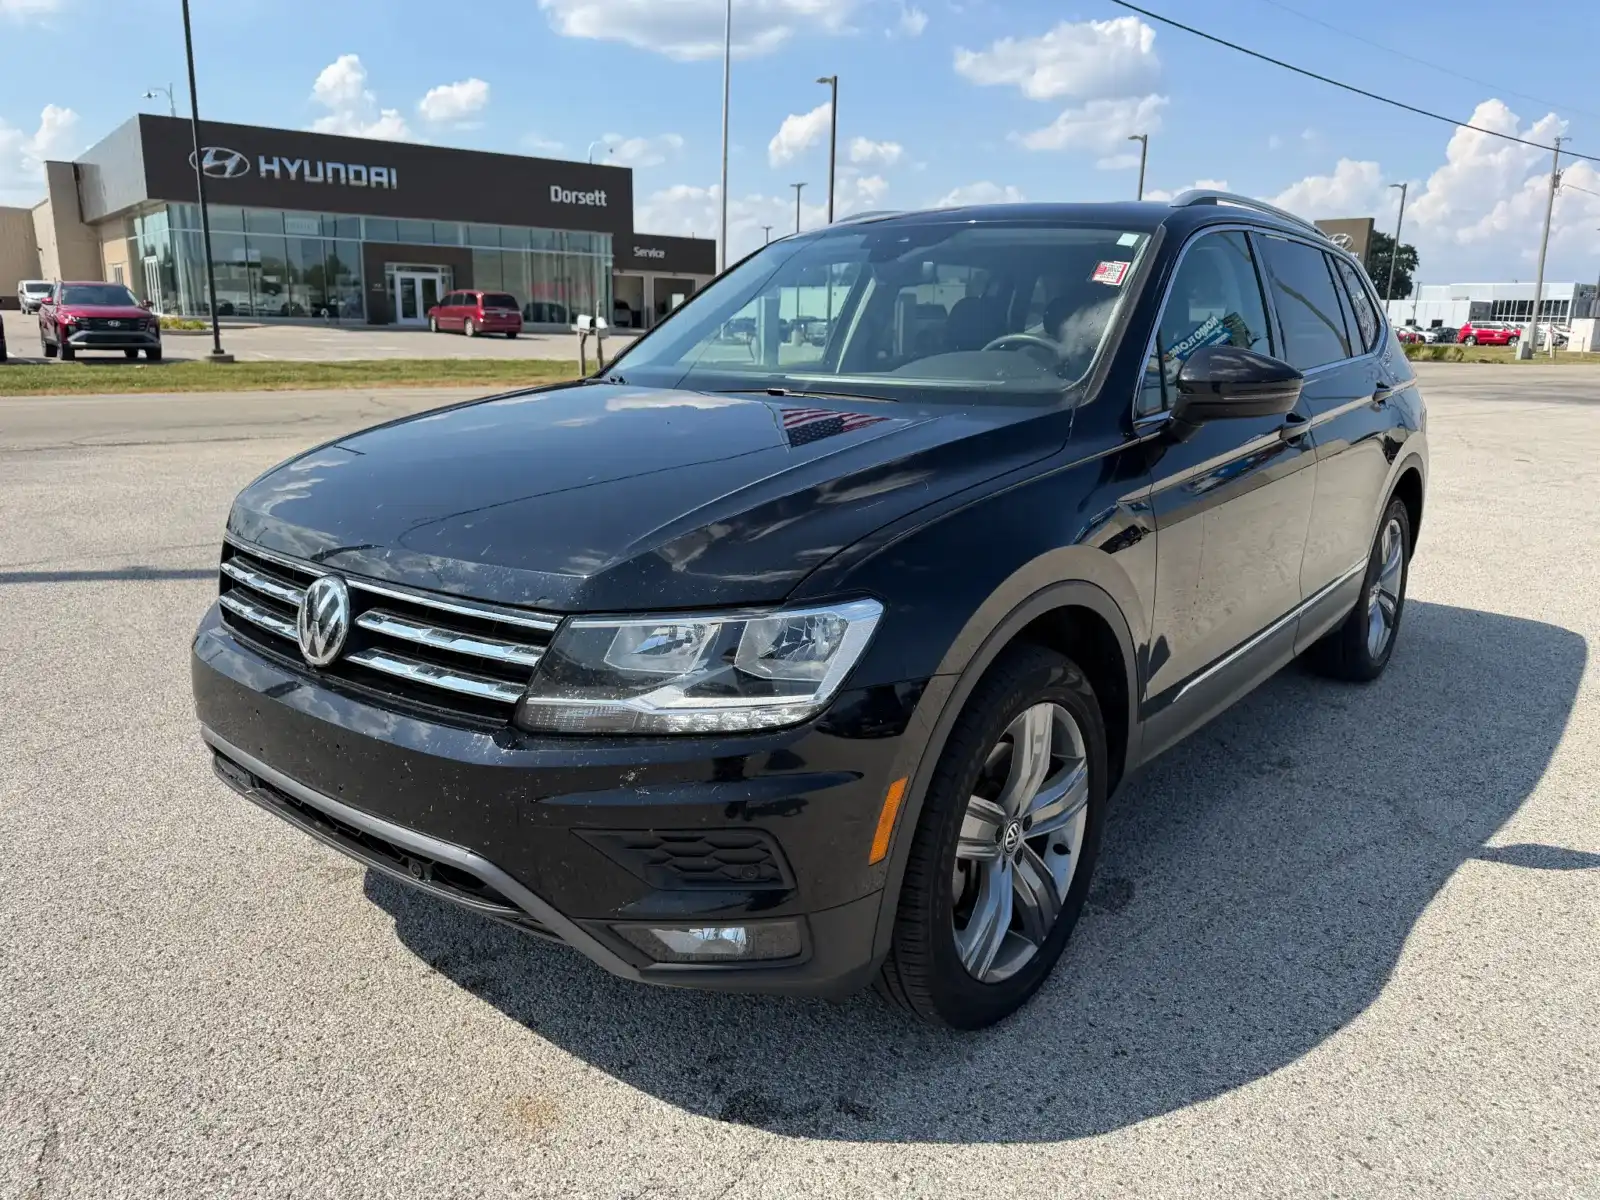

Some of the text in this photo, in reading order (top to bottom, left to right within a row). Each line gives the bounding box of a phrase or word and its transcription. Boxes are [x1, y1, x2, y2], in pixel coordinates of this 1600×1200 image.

[258, 156, 398, 190] HYUNDAI
[550, 185, 607, 207] Dorsett
[633, 246, 665, 259] Service
